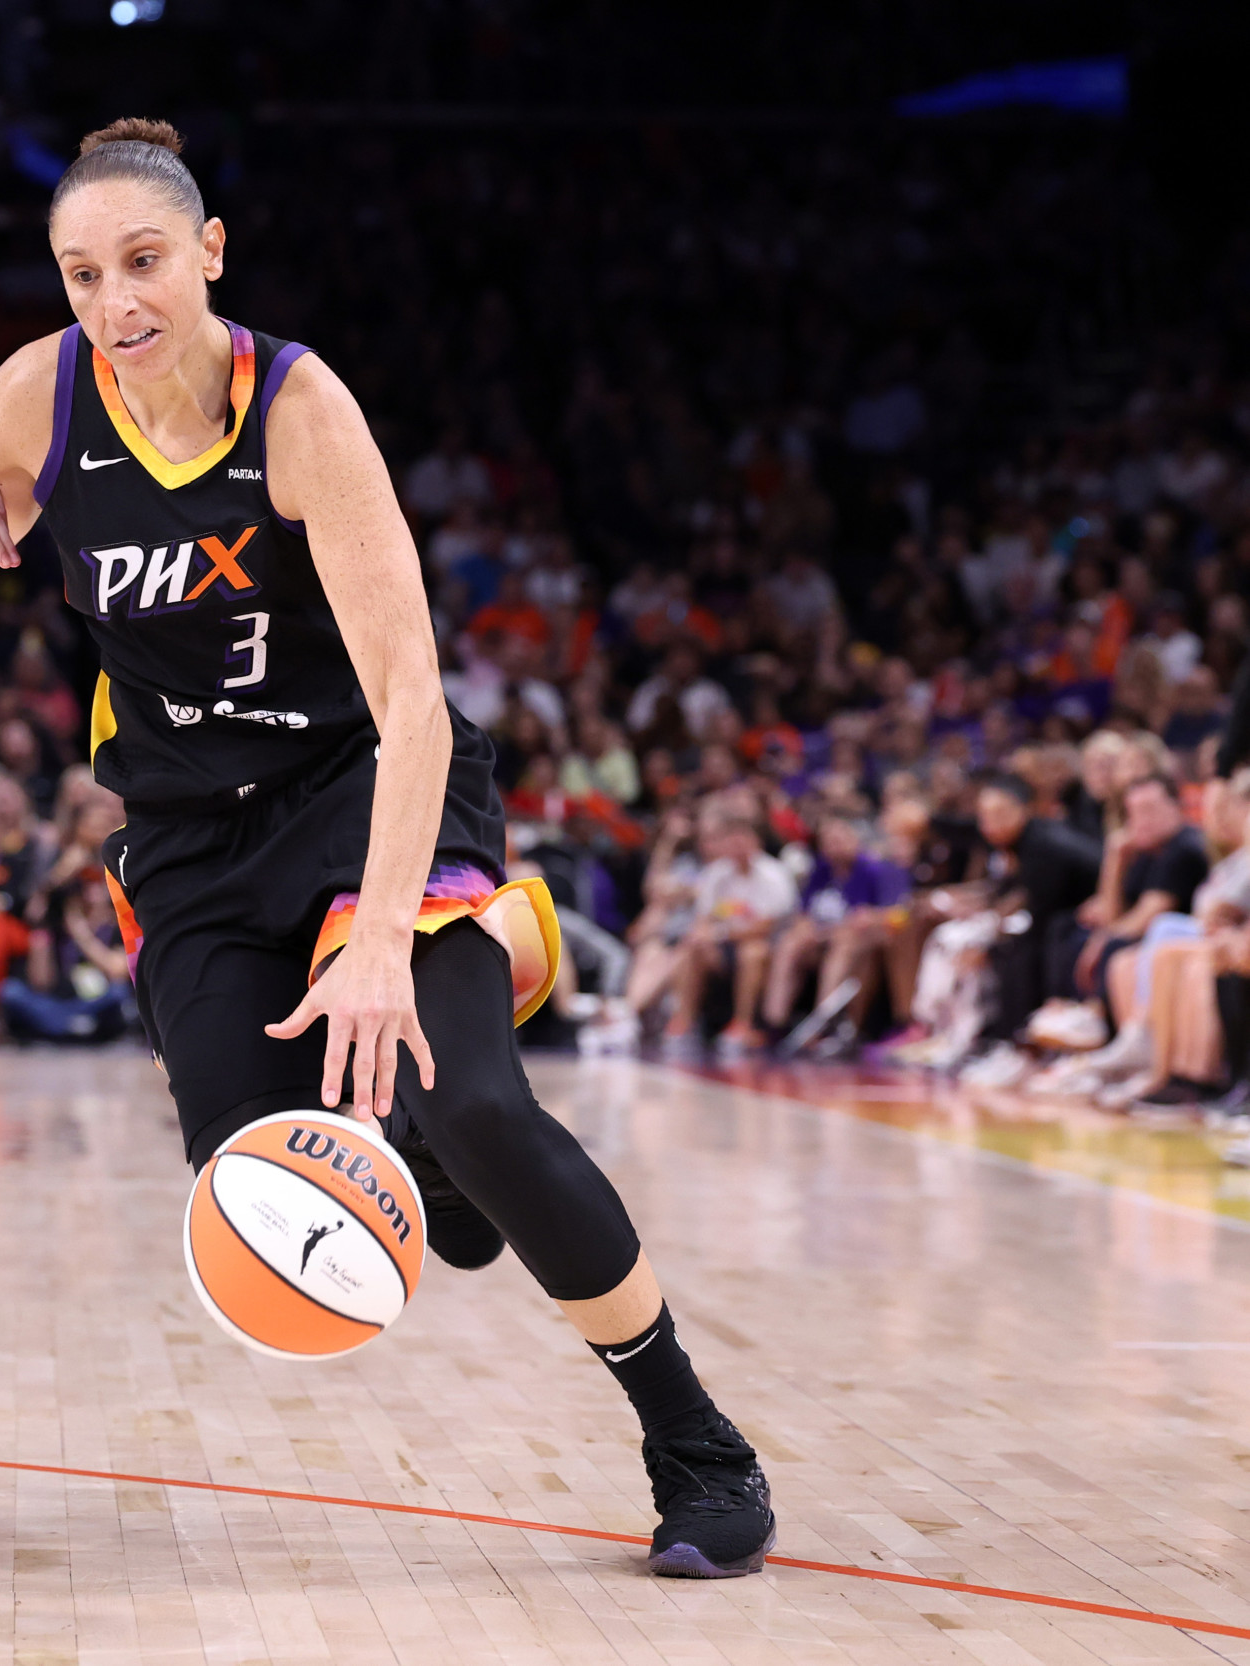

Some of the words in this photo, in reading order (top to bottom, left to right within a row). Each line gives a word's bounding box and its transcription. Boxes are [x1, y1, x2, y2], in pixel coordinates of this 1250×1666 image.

[85, 525, 260, 617] PHX
[220, 611, 270, 692] 3
[286, 1126, 412, 1248] Wilson
